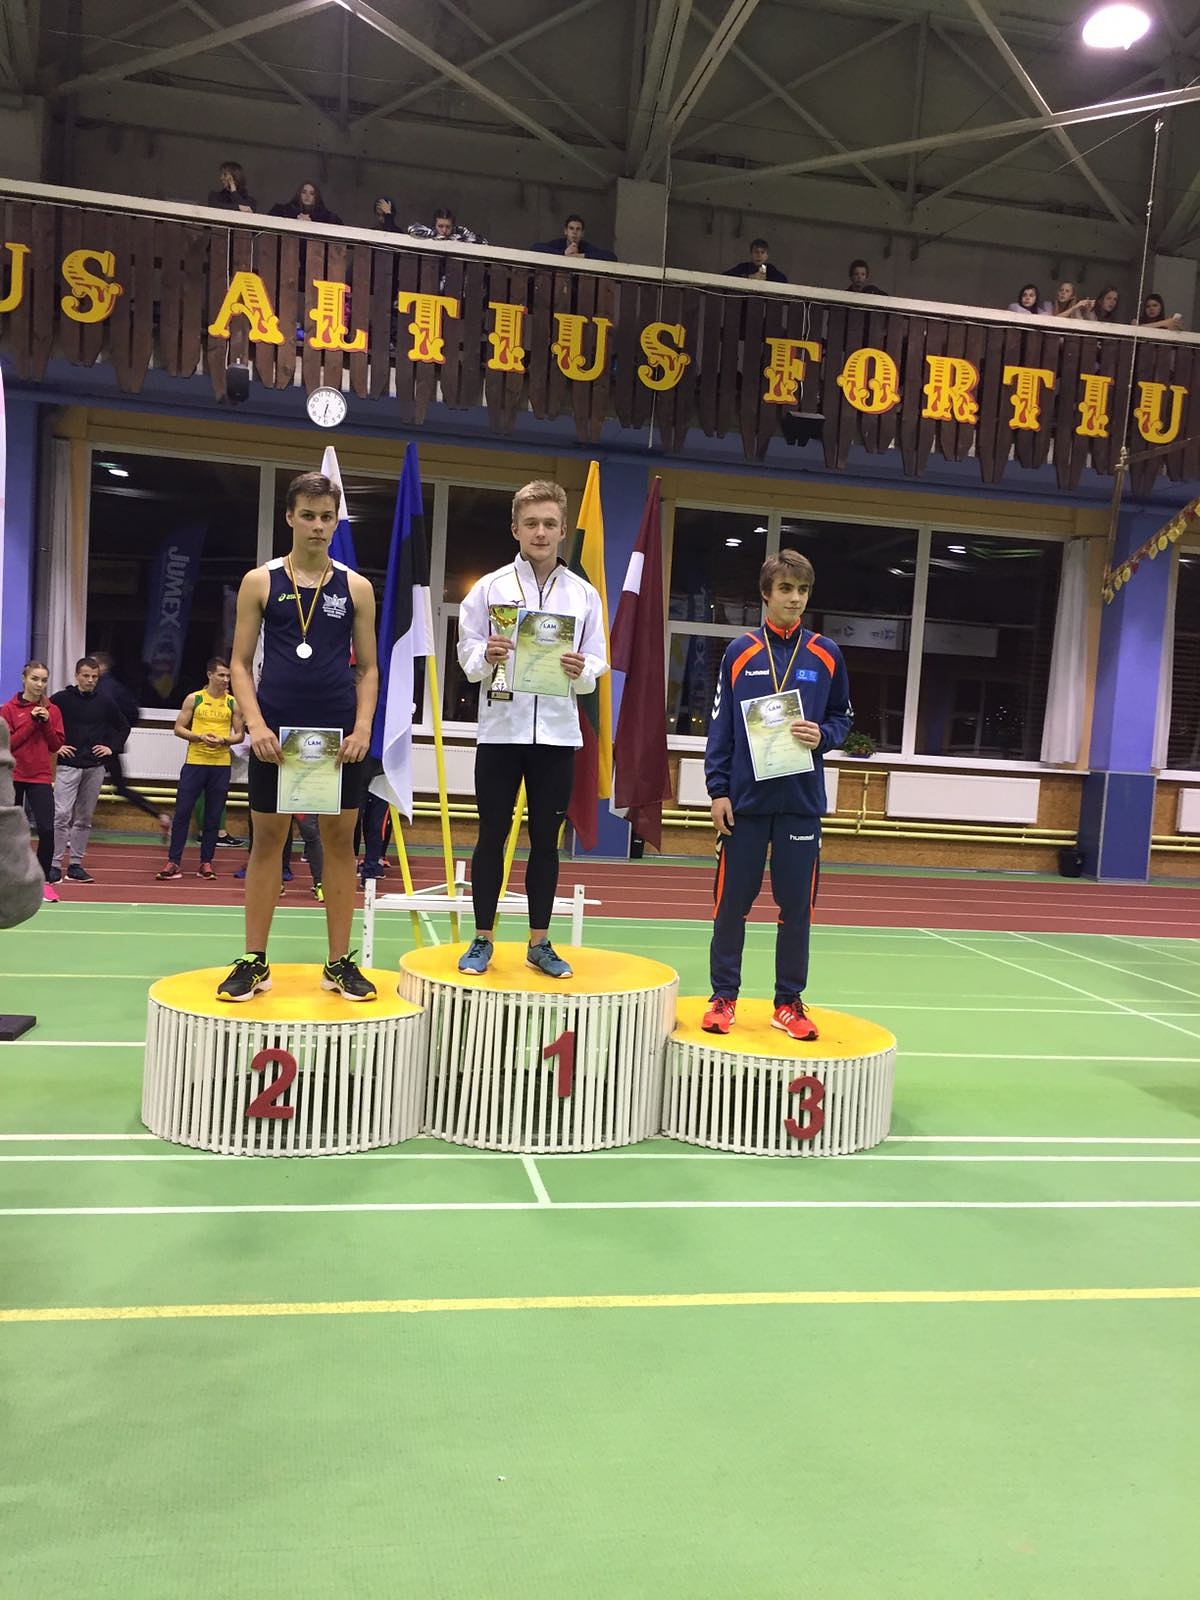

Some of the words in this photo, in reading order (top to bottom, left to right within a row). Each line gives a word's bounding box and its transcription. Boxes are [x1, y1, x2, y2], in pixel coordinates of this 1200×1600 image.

[208, 271, 691, 391] ALTIUS
[762, 337, 1188, 444] FORTIU
[160, 545, 190, 628] JUMEX
[245, 1048, 298, 1120] 2
[543, 1030, 577, 1099] 1
[783, 1074, 826, 1141] 3
